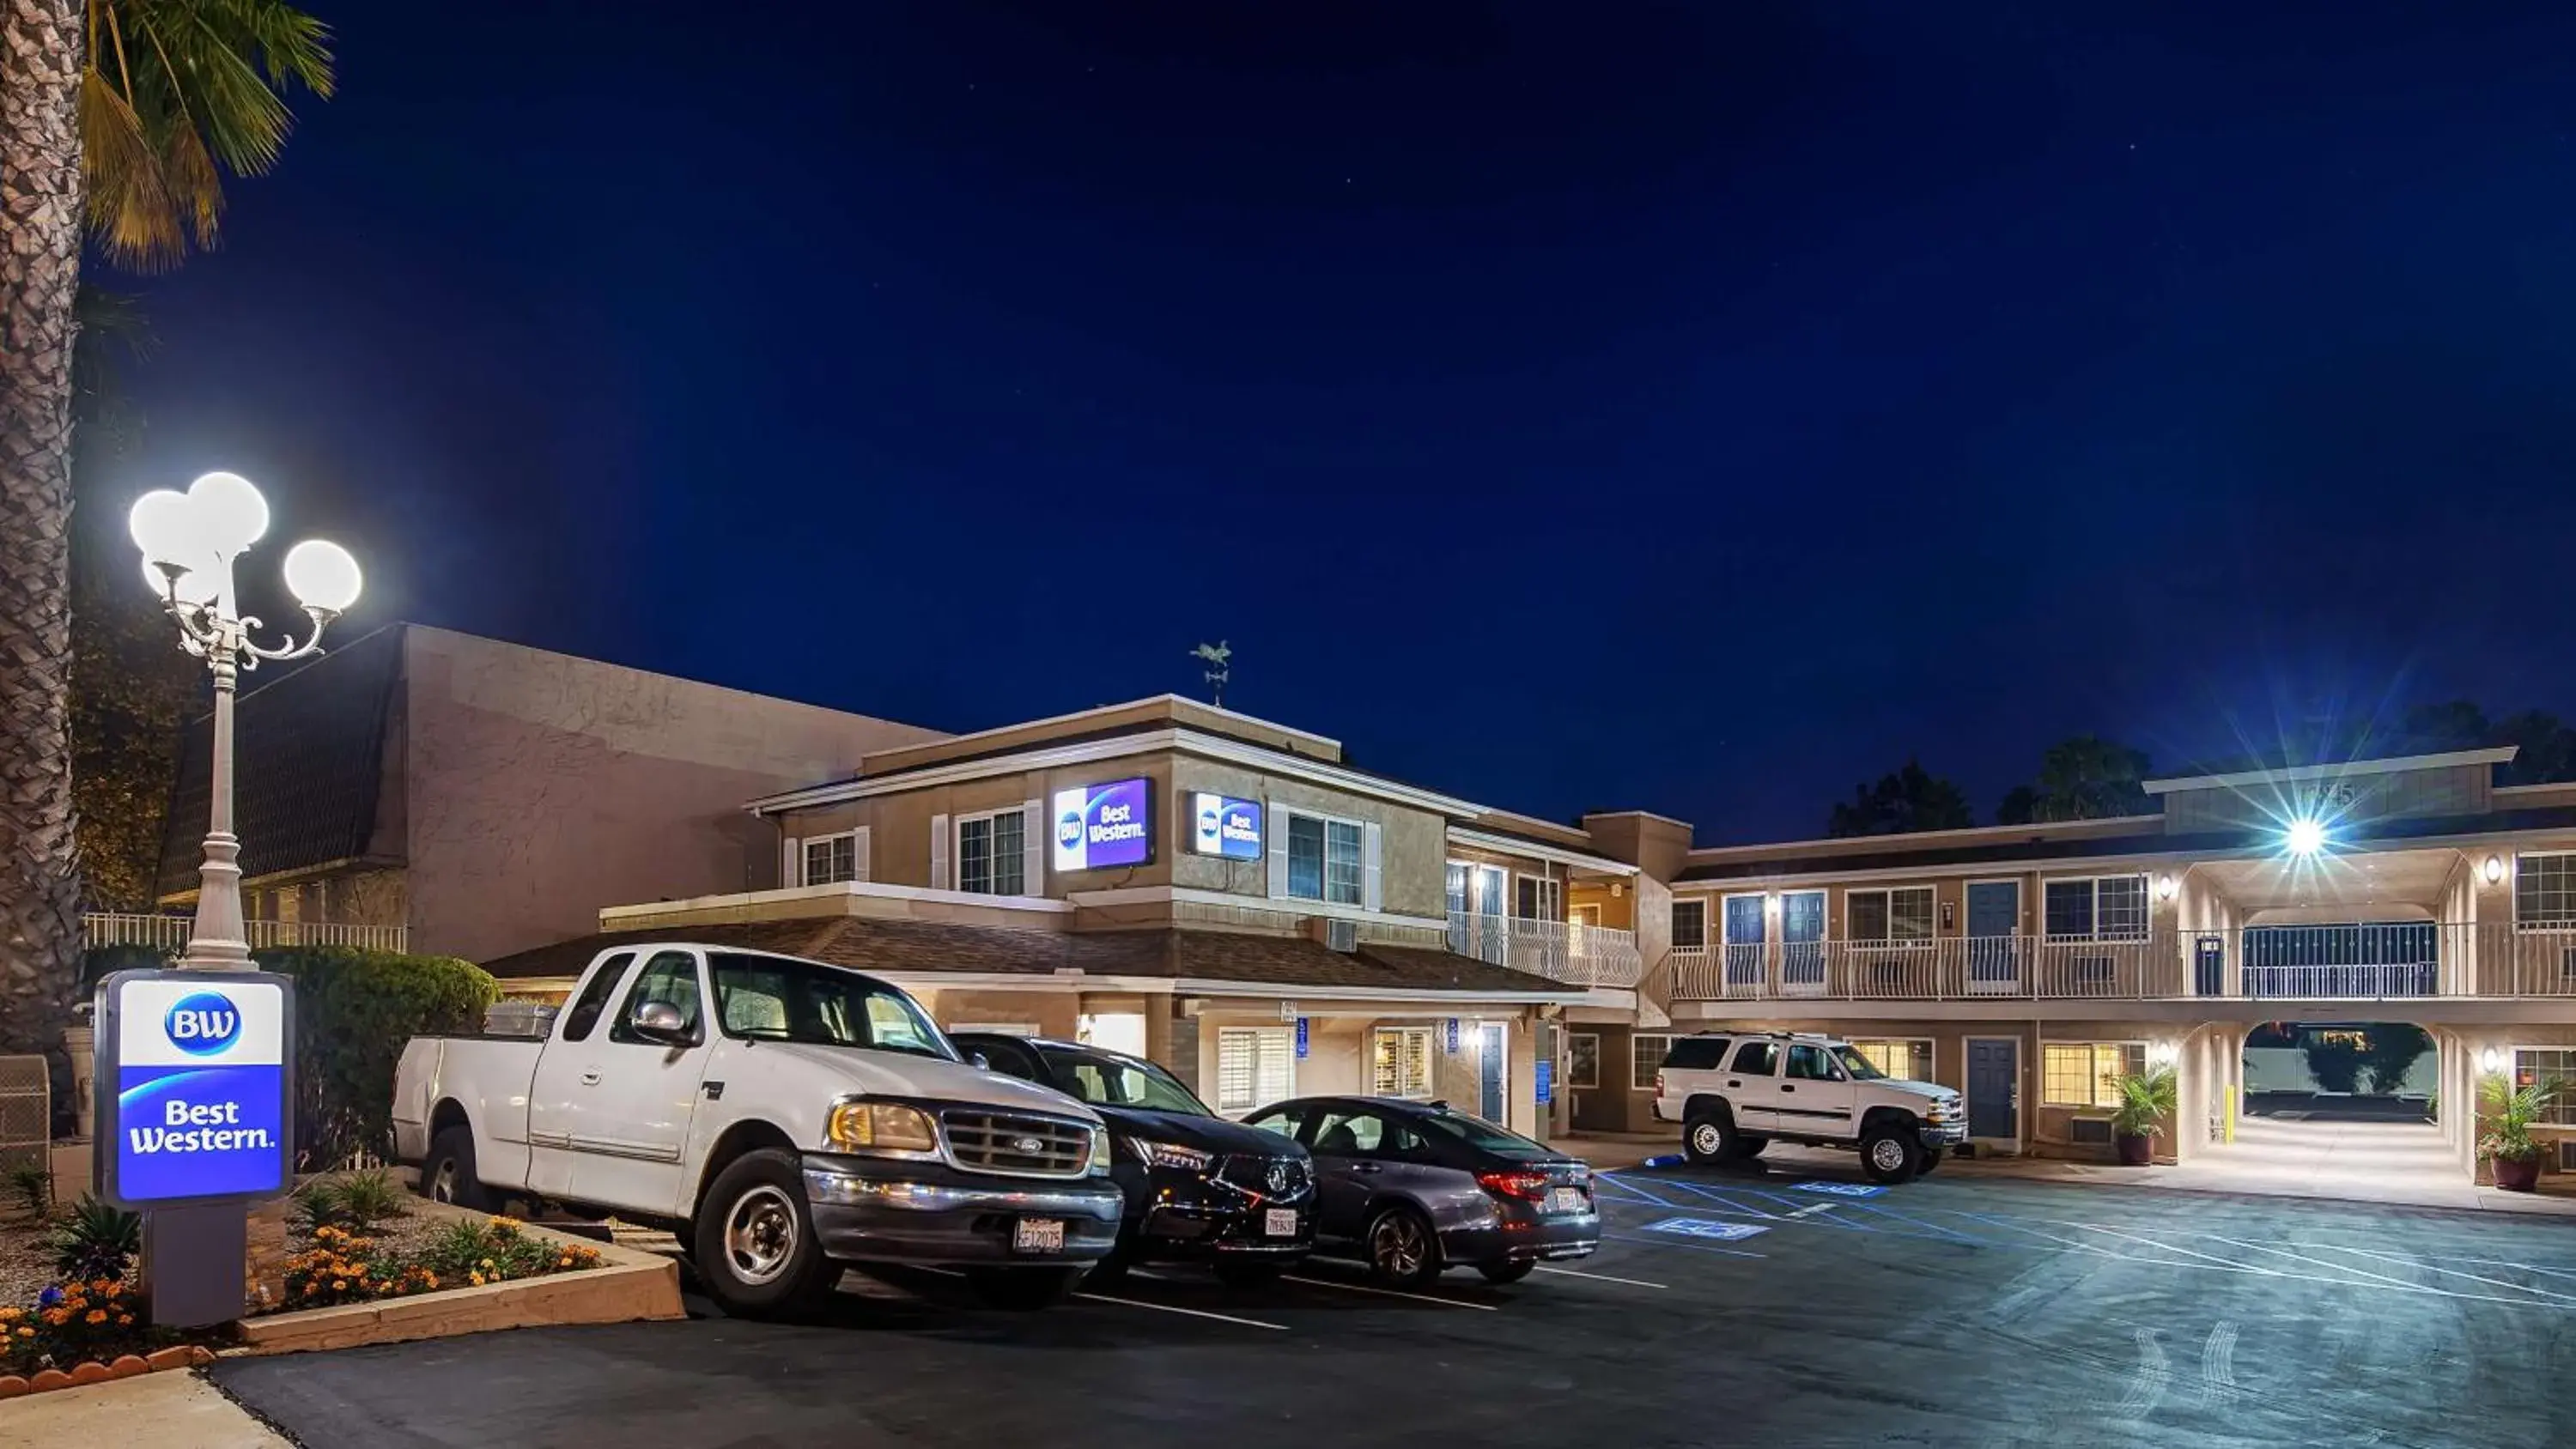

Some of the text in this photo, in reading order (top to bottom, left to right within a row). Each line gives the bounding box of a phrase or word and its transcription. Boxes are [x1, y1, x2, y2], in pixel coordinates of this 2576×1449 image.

[1101, 804, 1131, 824] Best
[1060, 822, 1081, 840] BW
[173, 1009, 234, 1040] BW
[166, 1100, 239, 1126] Best
